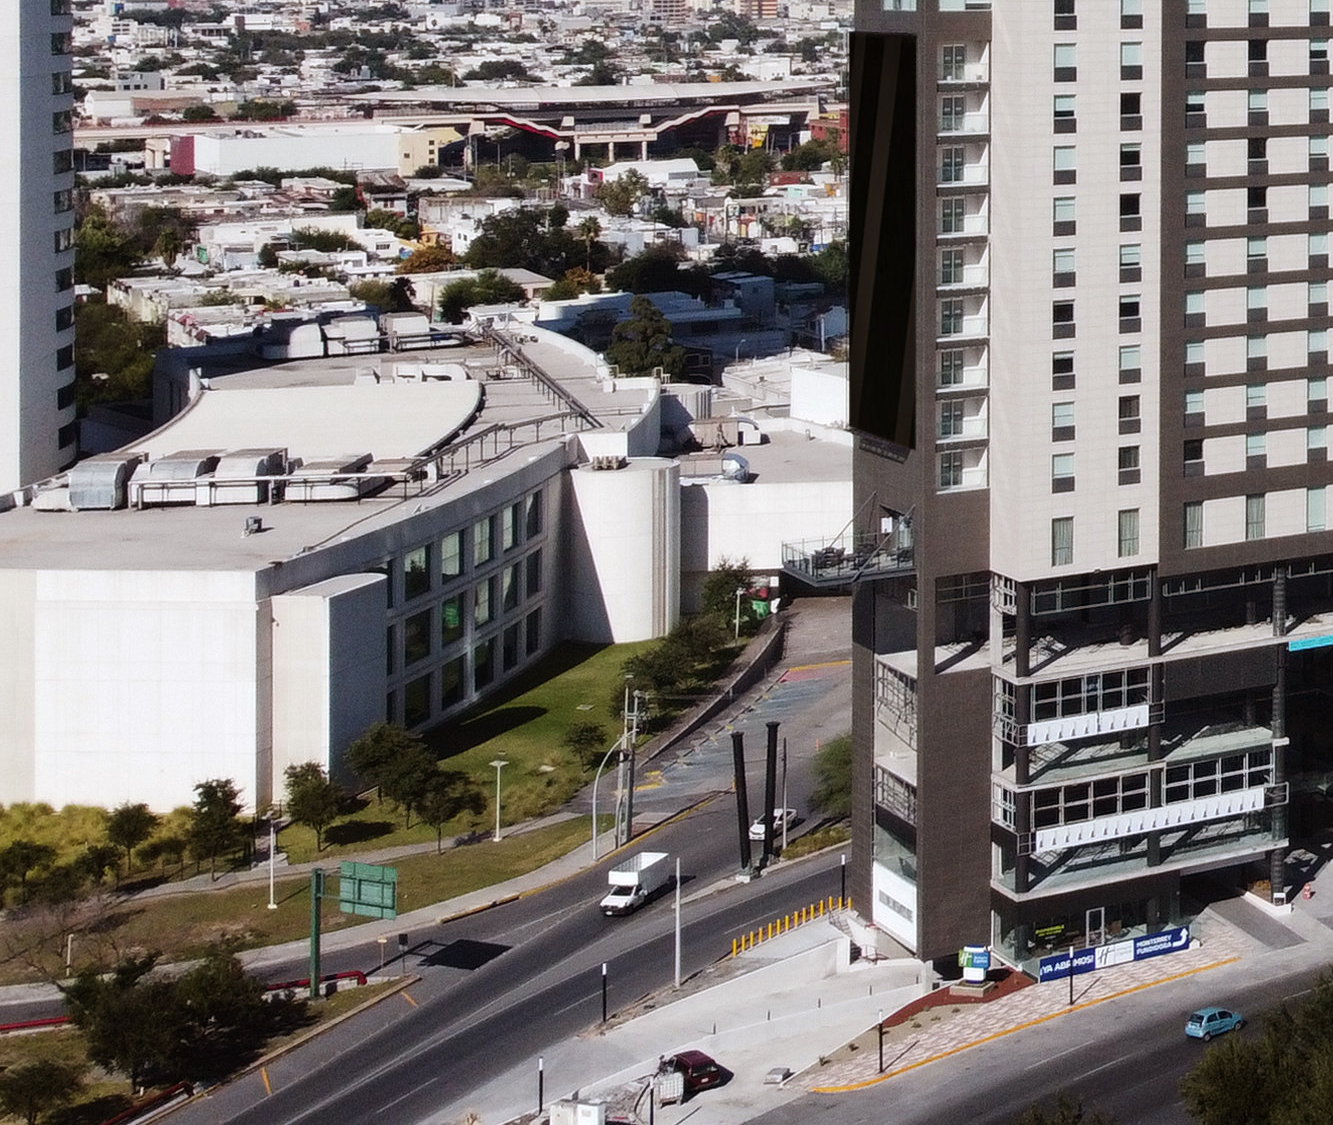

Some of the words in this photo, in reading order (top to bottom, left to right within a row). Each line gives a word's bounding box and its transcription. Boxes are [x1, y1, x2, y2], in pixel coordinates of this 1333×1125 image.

[1136, 934, 1172, 948] MONTERREY
[1136, 941, 1172, 955] FUNDIDORA
[1054, 955, 1094, 971] ABRMOS!
